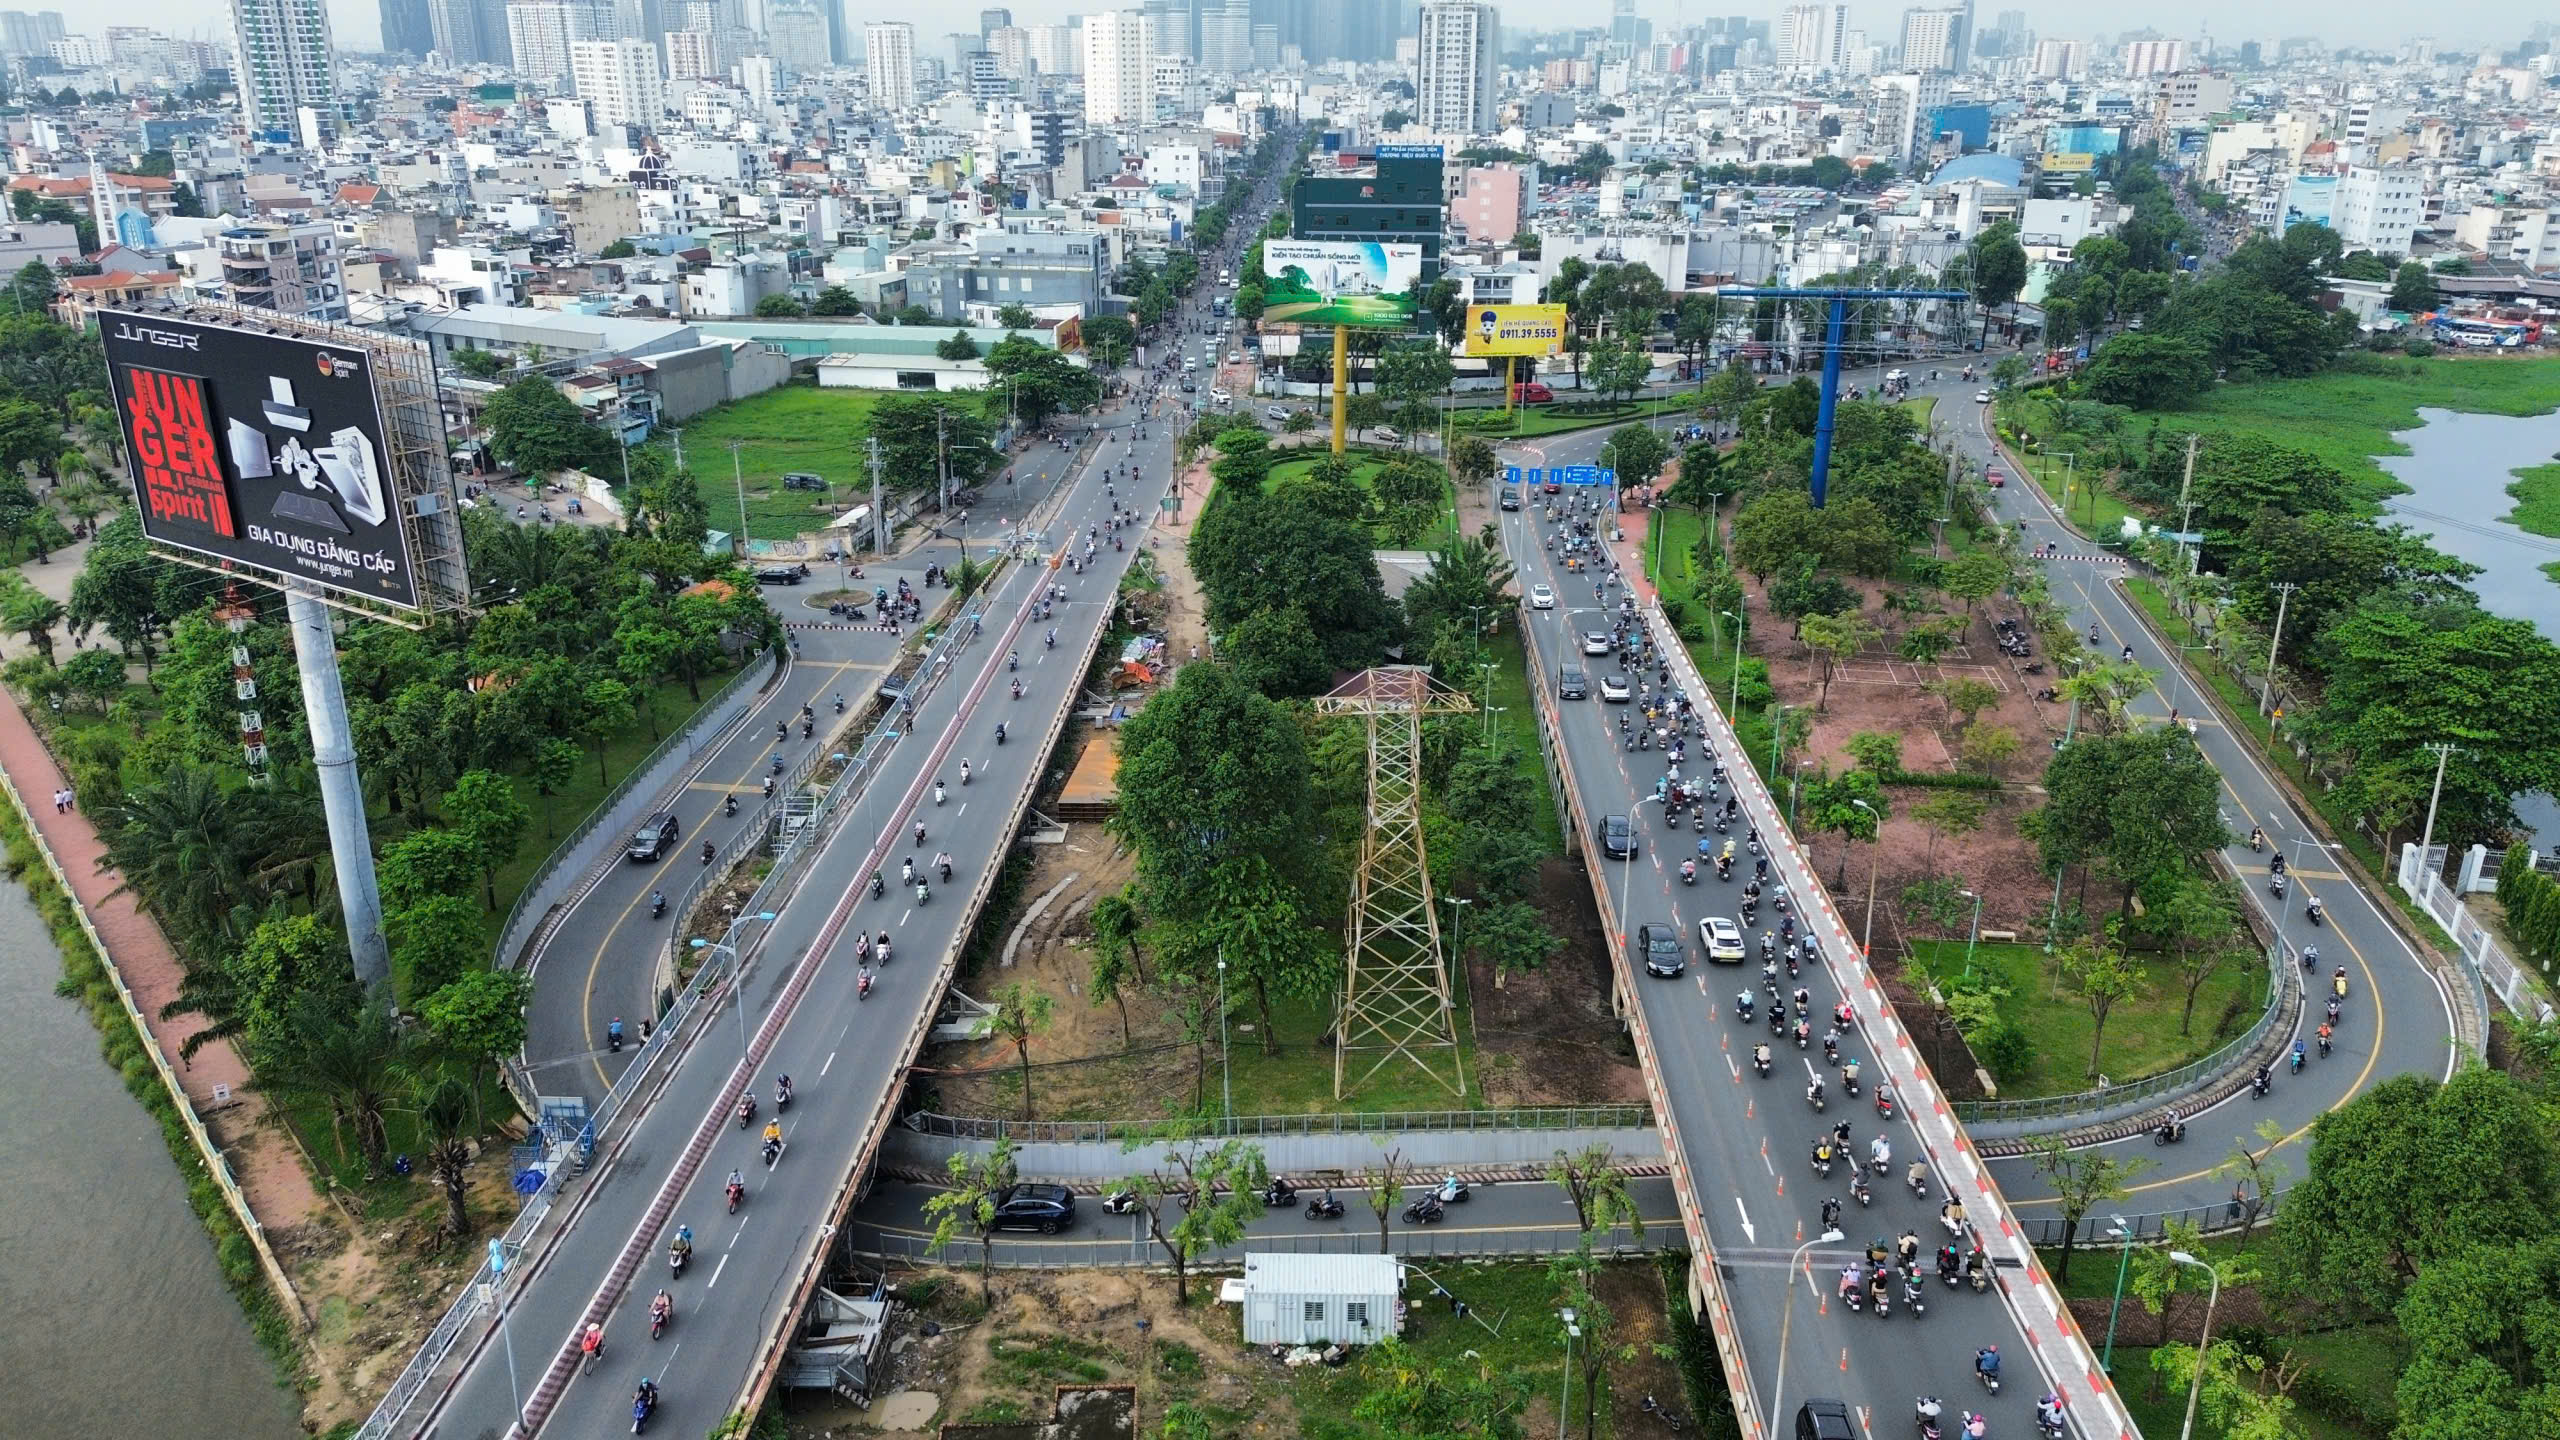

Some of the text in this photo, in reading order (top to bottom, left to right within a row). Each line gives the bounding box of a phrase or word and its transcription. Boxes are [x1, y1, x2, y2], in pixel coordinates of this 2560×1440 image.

[1500, 328, 1557, 338] 0911.39.5555
[332, 357, 358, 371] German
[127, 368, 207, 433] JUN
[133, 415, 223, 481] GER
[248, 525, 396, 575] GIA DỤNG ĐẲNG CẤP
[296, 555, 354, 579] www.junger.vn
